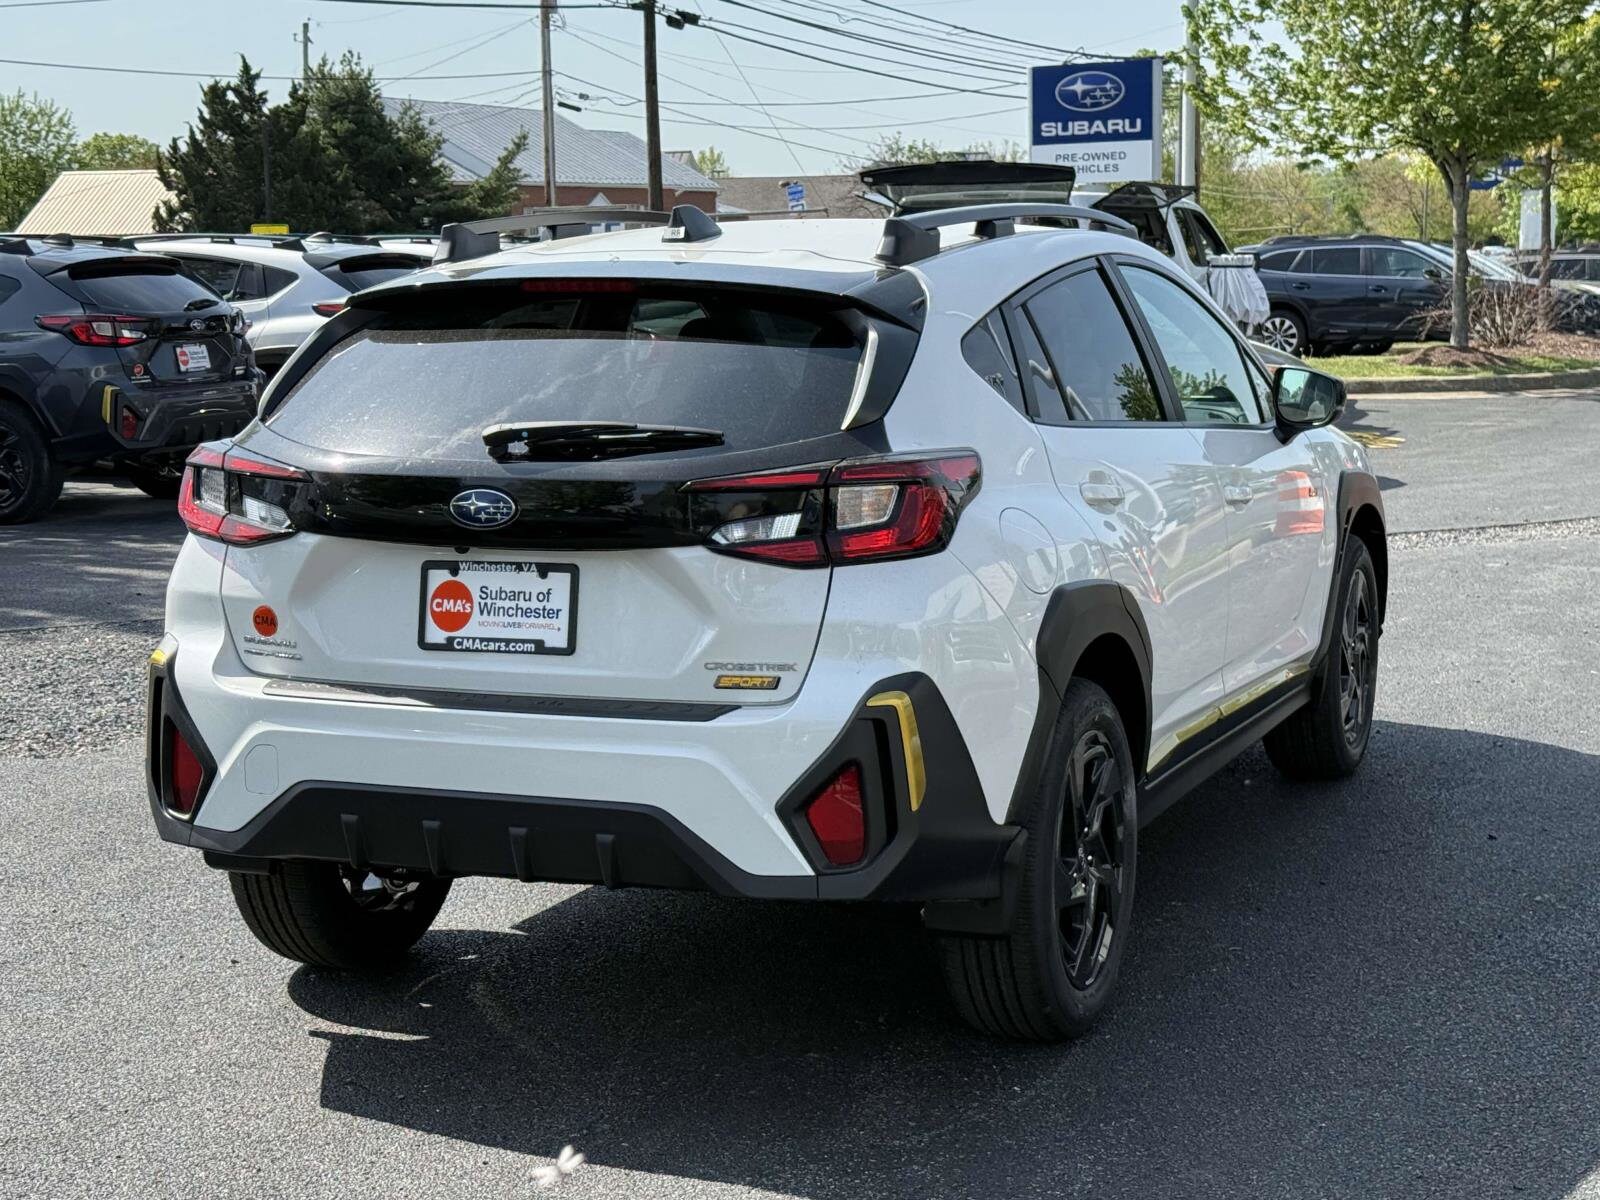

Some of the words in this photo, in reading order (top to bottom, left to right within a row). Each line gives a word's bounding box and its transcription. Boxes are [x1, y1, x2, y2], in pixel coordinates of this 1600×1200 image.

[1040, 118, 1142, 137] SUBARU
[1055, 151, 1127, 163] PRE-OWNED
[458, 561, 519, 573] Winchester,
[522, 562, 538, 572] VA
[478, 586, 532, 602] Subaru
[536, 588, 552, 602] of
[432, 598, 472, 613] CMA's
[478, 601, 562, 619] Winchester
[453, 638, 535, 652] CMAcars.com
[703, 662, 799, 671] CROSSTREK
[718, 677, 775, 687] SPORT
